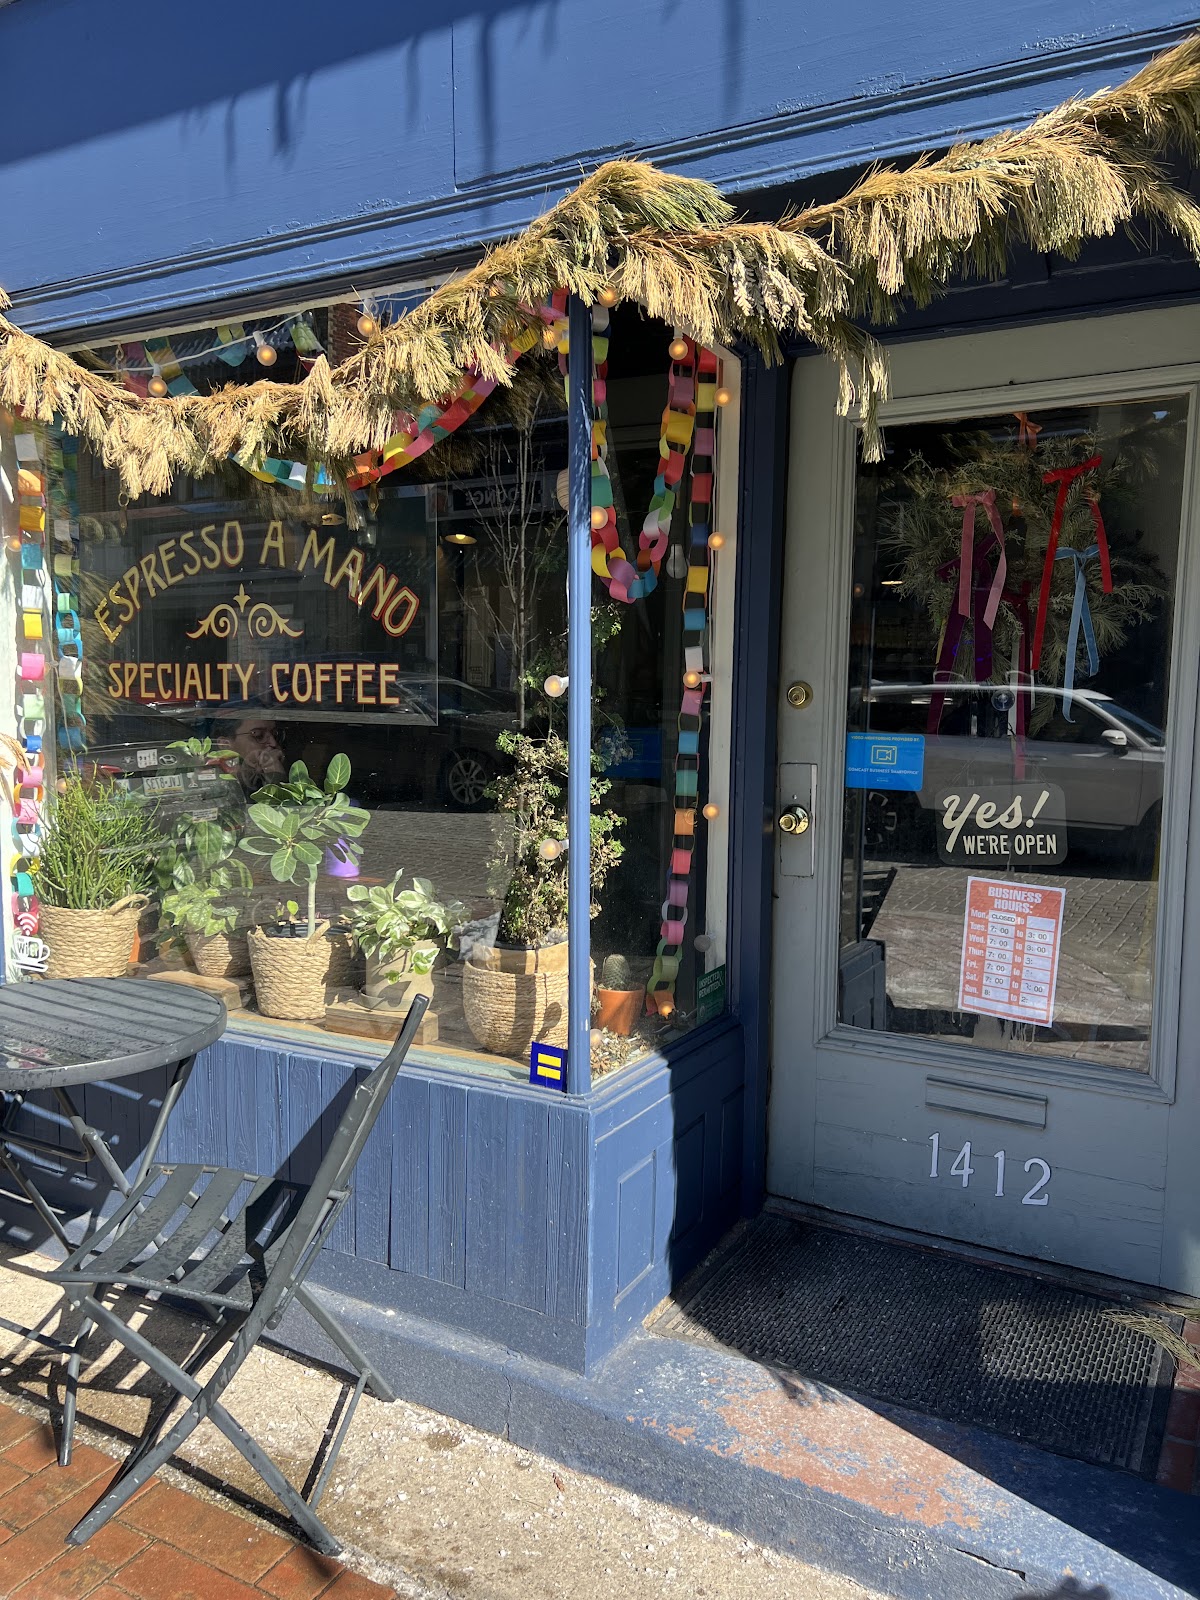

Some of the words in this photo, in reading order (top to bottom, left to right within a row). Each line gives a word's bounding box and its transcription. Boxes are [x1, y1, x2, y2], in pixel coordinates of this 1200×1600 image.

[94, 520, 244, 643] ESPRESSO
[259, 520, 286, 567] A
[297, 529, 420, 637] MANO
[108, 662, 255, 701] SPECIALTY
[271, 663, 400, 705] COFFEE
[942, 790, 1050, 853] Yes!
[963, 835, 1010, 855] WE'RE
[1014, 834, 1057, 855] OPEN
[988, 886, 1042, 903] BUSINESS
[994, 899, 1033, 914] HOURS:
[991, 913, 1015, 923] CLOSED
[1016, 942, 1022, 950] to
[1014, 955, 1021, 963] to
[1012, 981, 1019, 989] to
[928, 1131, 1052, 1206] 1412
